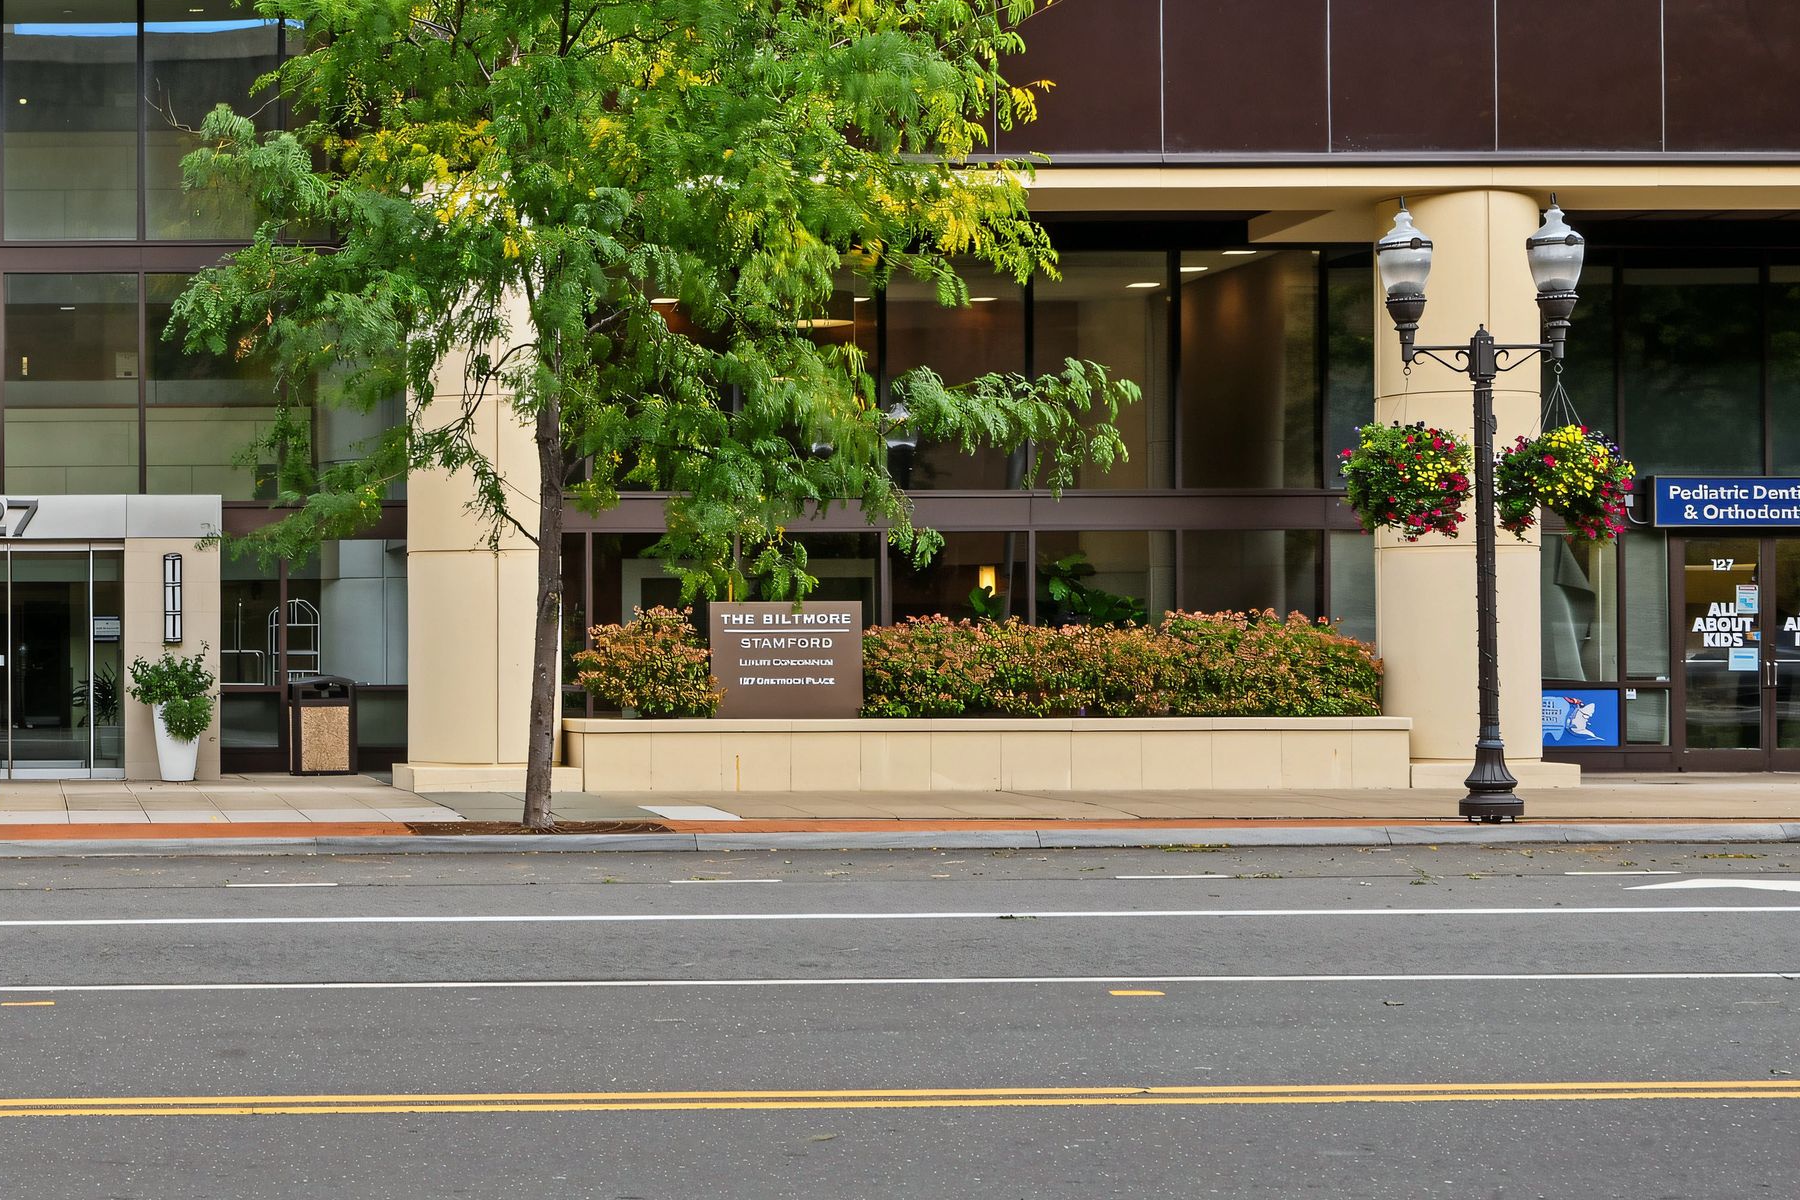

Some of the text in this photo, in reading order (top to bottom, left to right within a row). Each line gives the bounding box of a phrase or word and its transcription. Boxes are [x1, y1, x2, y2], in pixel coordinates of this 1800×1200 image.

[1669, 484, 1749, 500] Pediatric
[1683, 504, 1800, 519] & Orthodont
[1711, 558, 1734, 571] 127
[1707, 602, 1738, 617] ALL
[720, 613, 852, 625] THE BILTMORE
[1692, 617, 1754, 632] ABOUT
[740, 637, 833, 649] STAMFORD
[1703, 632, 1744, 647] KIDS
